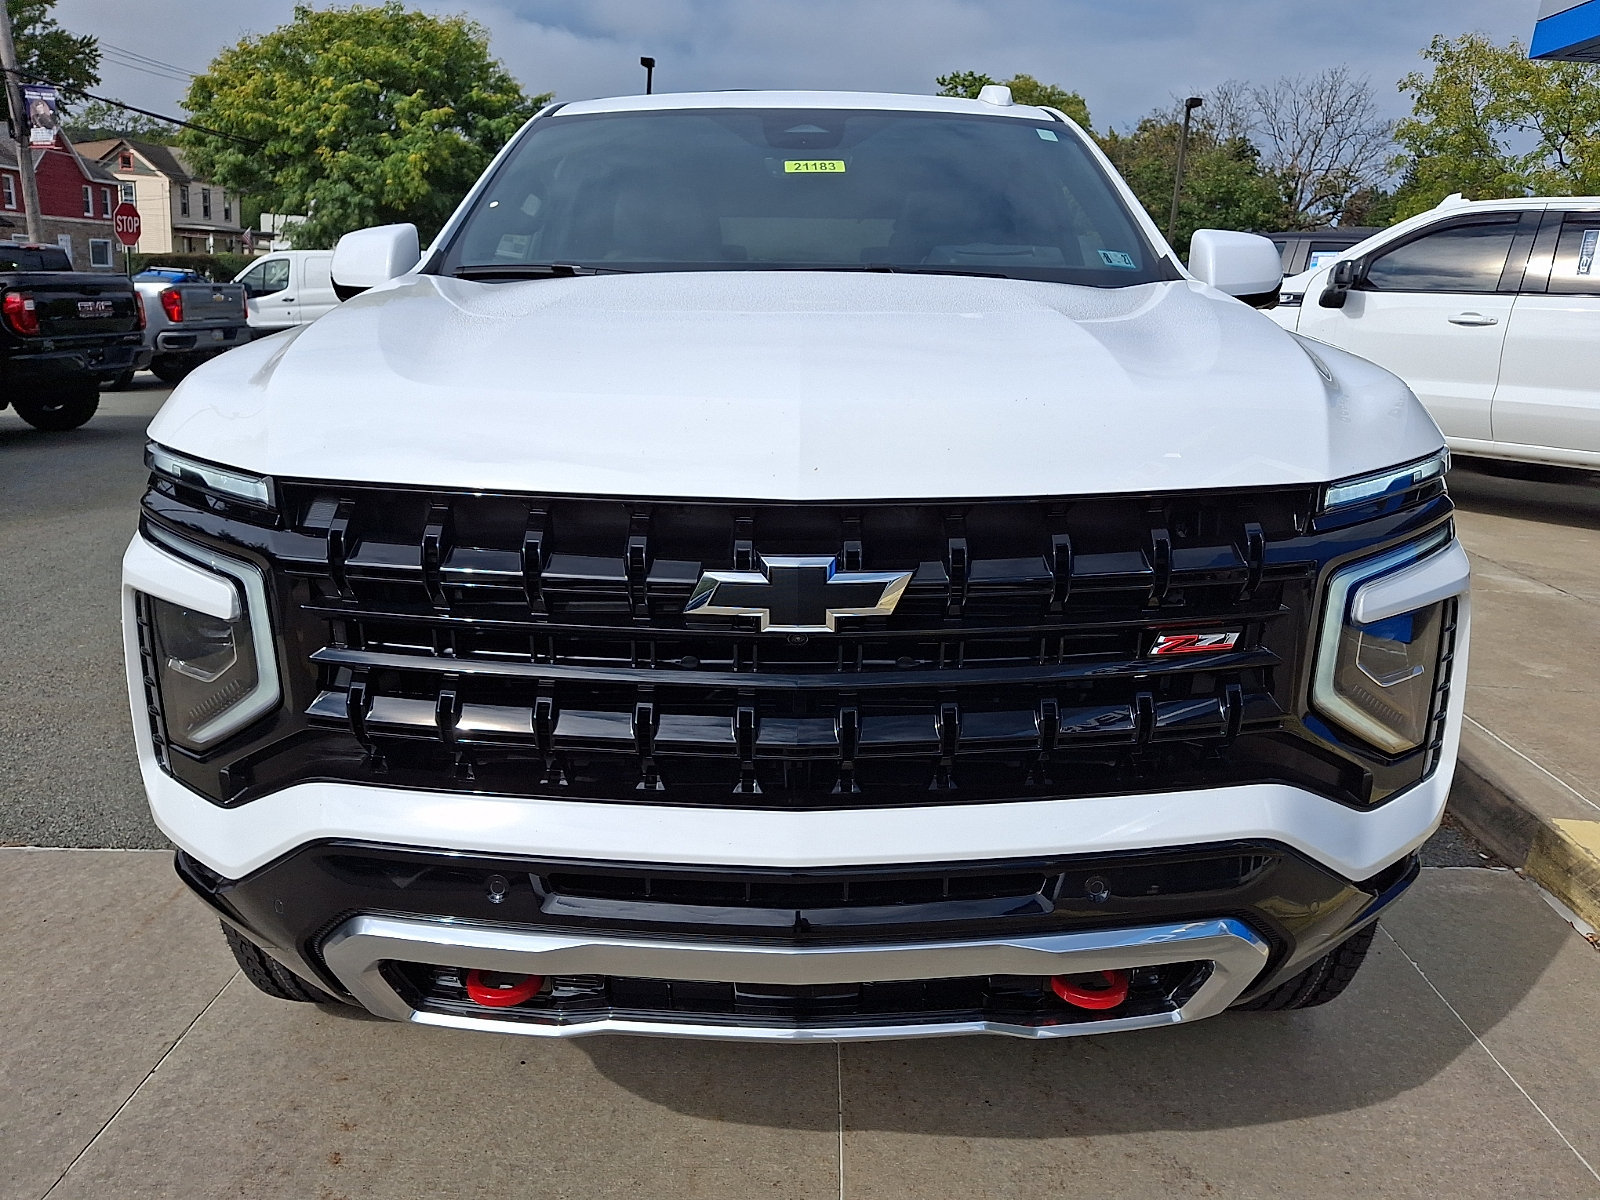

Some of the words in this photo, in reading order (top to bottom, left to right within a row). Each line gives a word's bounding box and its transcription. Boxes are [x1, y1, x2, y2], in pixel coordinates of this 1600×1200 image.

[794, 162, 836, 171] 21183
[116, 215, 140, 233] STOP
[77, 301, 113, 312] GMC
[1150, 632, 1241, 655] Z71
